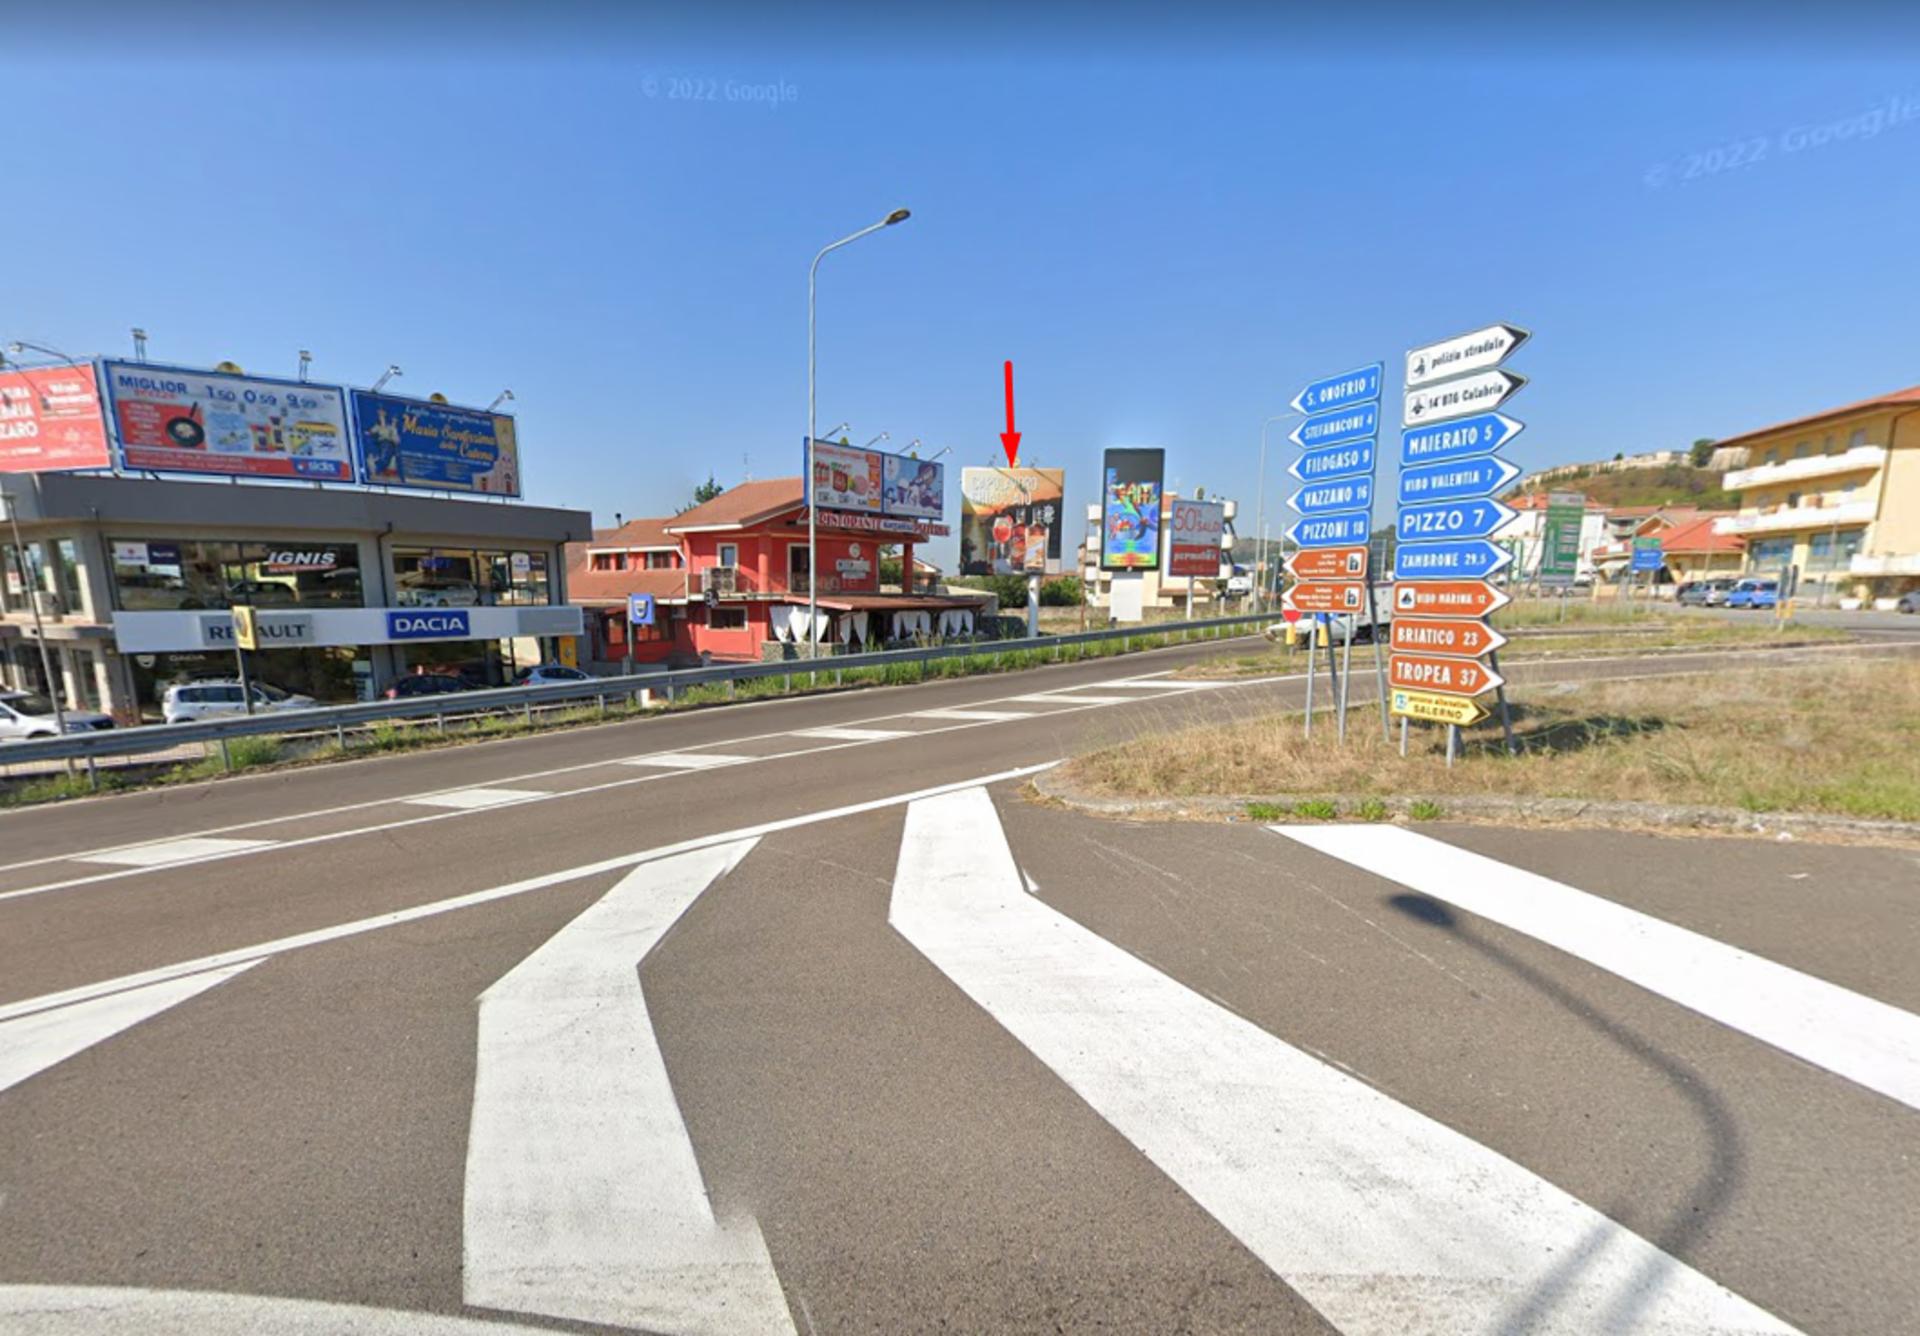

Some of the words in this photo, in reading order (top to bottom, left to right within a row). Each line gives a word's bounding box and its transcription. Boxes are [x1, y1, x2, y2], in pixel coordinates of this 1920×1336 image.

[1431, 351, 1461, 369] polizia
[1464, 337, 1505, 359] stradale
[118, 375, 187, 394] MIGLIOR
[1306, 392, 1317, 406] S.
[1320, 377, 1366, 403] ONOFRIO
[1371, 375, 1376, 389] 1
[1462, 383, 1504, 402] Calabria
[1366, 413, 1373, 426] 4
[1409, 426, 1479, 456] MAIERATO
[1484, 423, 1493, 441] 5
[1306, 450, 1359, 475] FILOGASO
[1362, 448, 1370, 463] 9
[1405, 478, 1428, 492] VIBO
[1431, 470, 1480, 489] VALENTIA
[1486, 468, 1493, 481] 7
[1304, 486, 1352, 507] VAZZANO
[1357, 485, 1367, 501] 16
[1302, 519, 1349, 540] PIZZONI
[1353, 520, 1364, 536] 18
[1403, 510, 1463, 533] PIZZO
[1472, 508, 1485, 528] 7
[269, 552, 336, 565] IGNIS
[1402, 552, 1459, 569] ZAMBRONE
[394, 617, 464, 632] DACIA
[1397, 626, 1455, 646] BRIATICO
[1463, 631, 1479, 647] 23
[1396, 662, 1452, 685] TROPEA
[1460, 669, 1478, 687] 37
[1414, 704, 1463, 719] SALERNO
